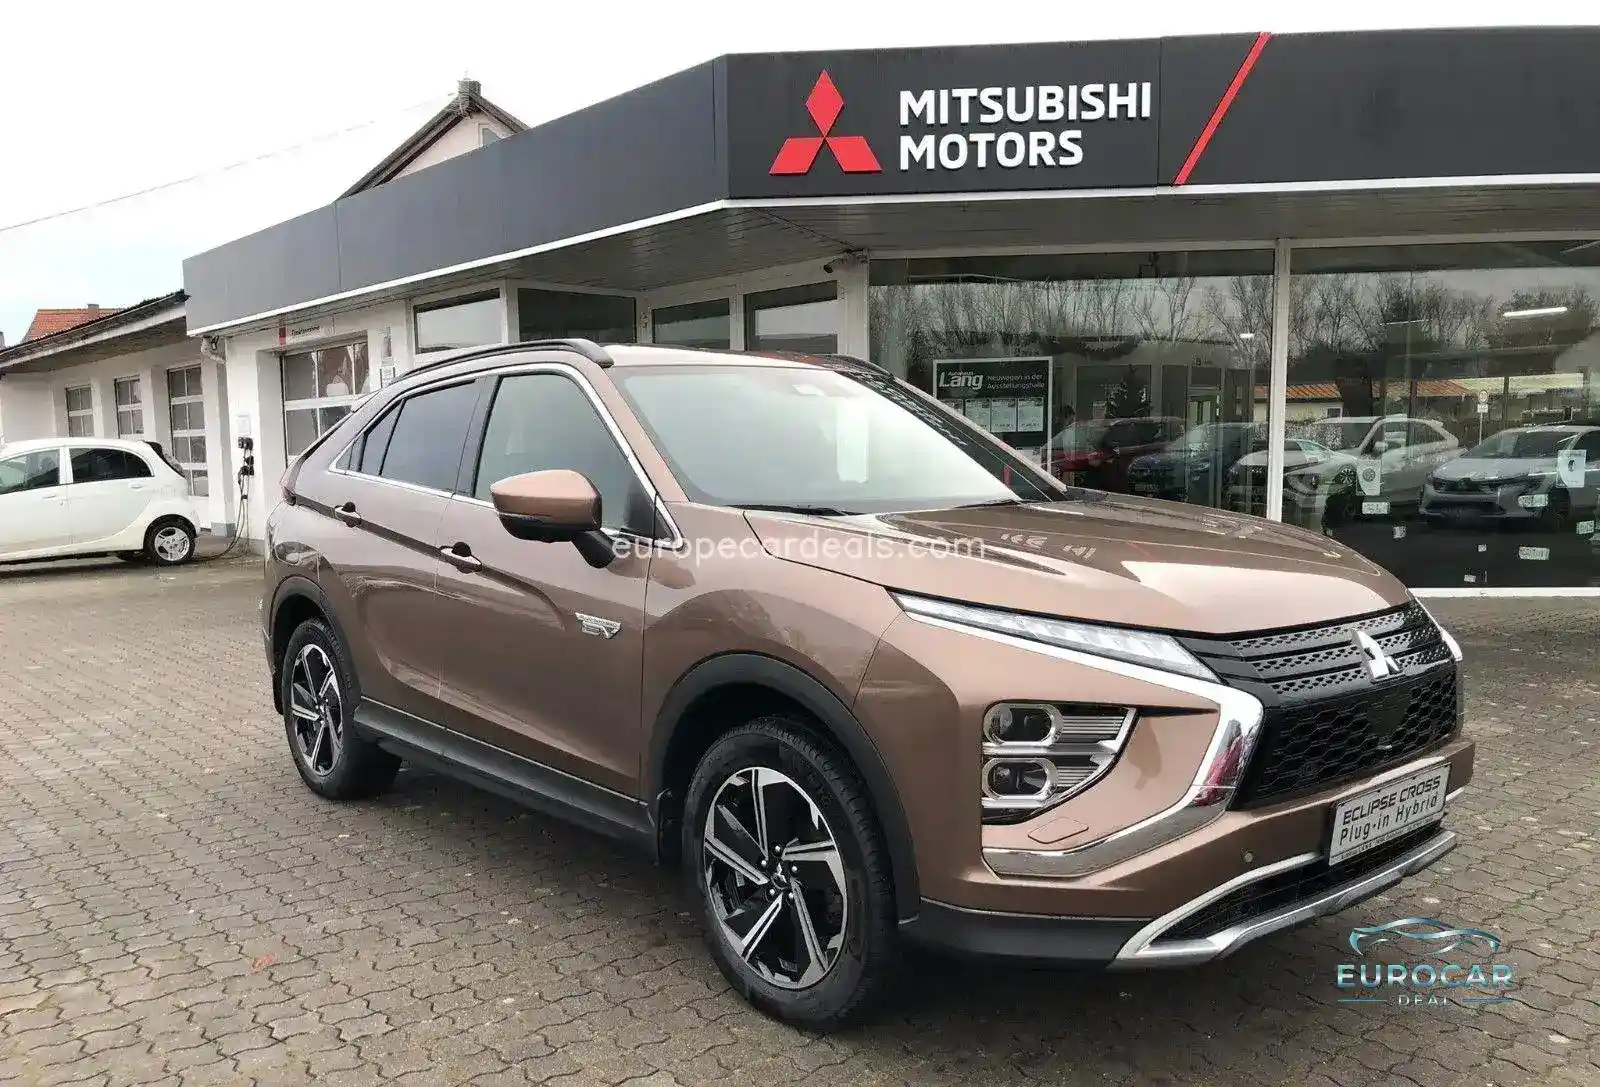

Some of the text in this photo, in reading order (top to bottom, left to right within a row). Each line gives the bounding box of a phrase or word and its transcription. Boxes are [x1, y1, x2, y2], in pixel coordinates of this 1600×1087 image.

[900, 82, 1152, 126] MITSUBISHI
[900, 130, 1084, 171] MOTORS
[939, 372, 984, 390] Lang
[1339, 814, 1390, 846] Plug-in
[1396, 794, 1438, 824] Hybrid
[1342, 775, 1441, 826] ECLIPSE CROSS
